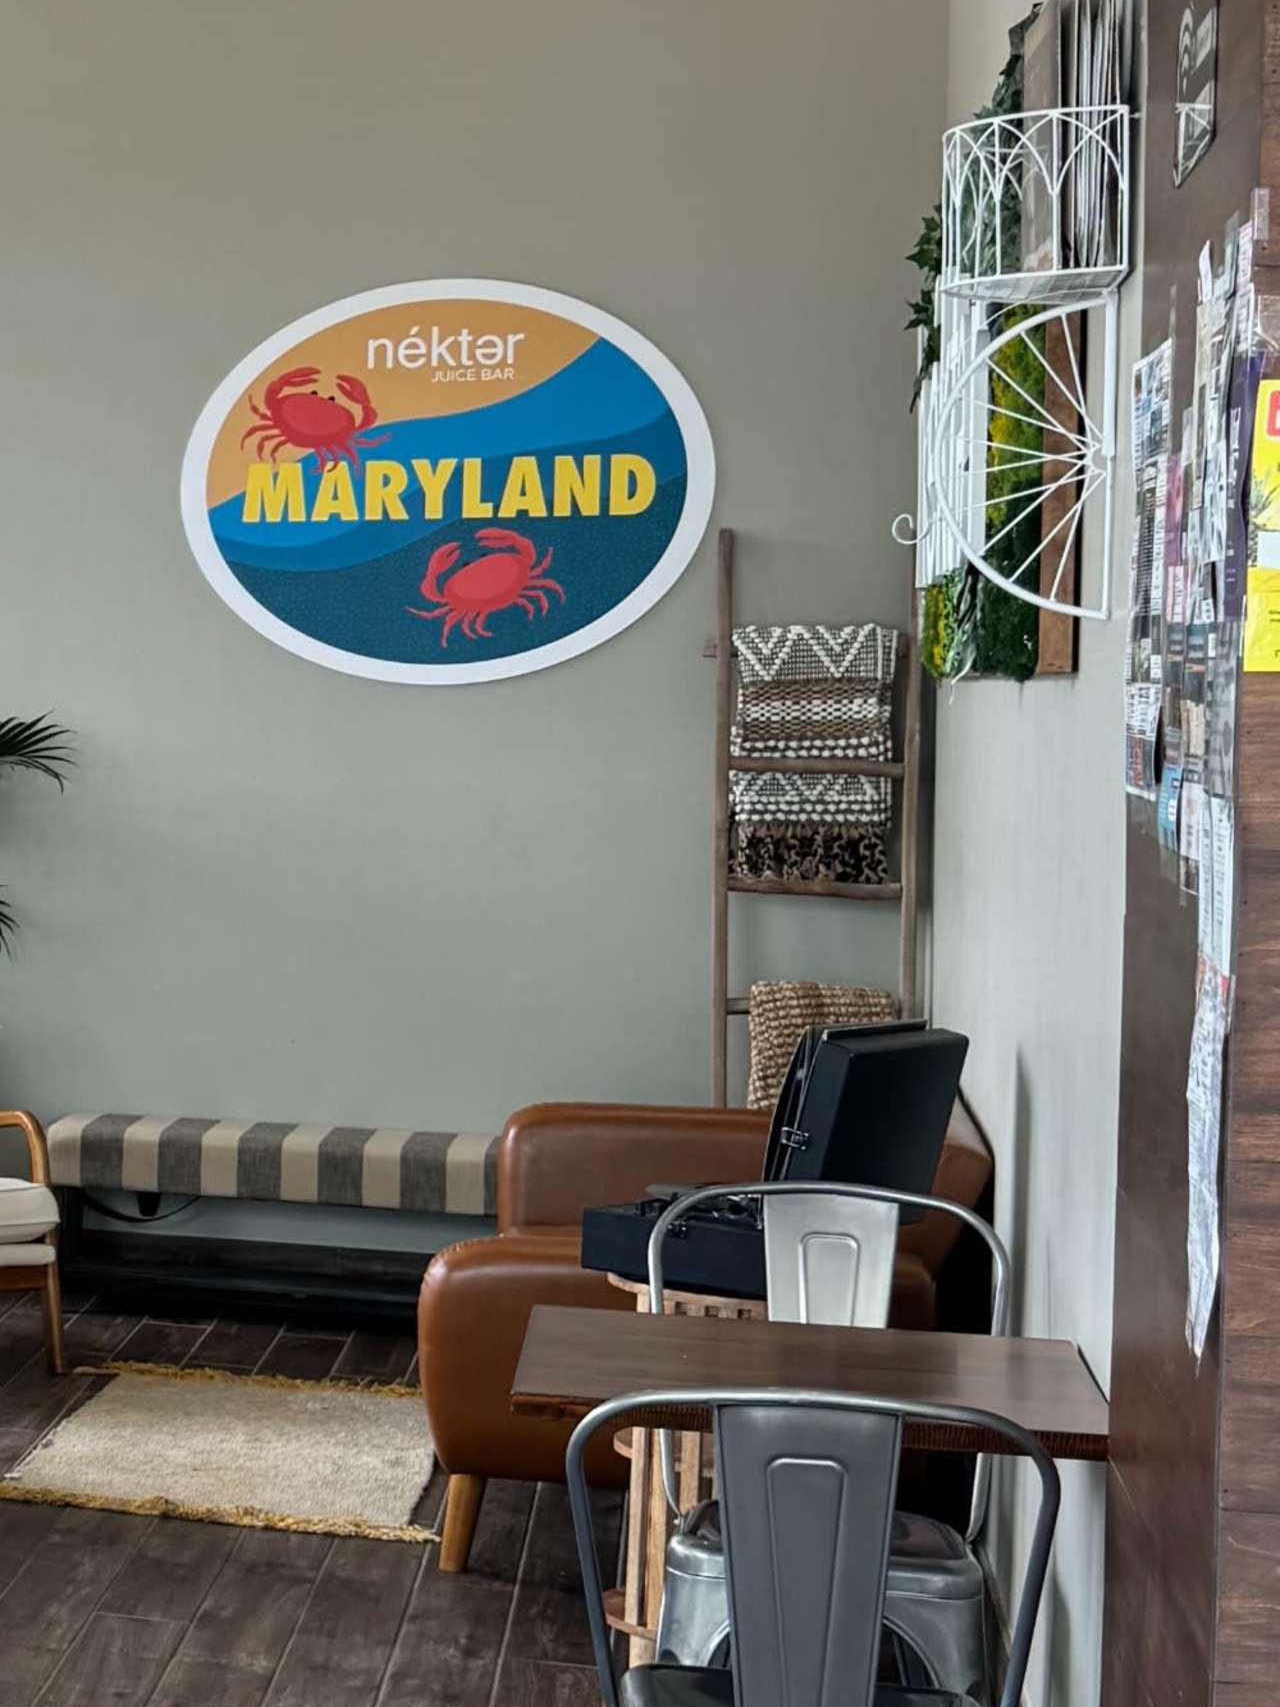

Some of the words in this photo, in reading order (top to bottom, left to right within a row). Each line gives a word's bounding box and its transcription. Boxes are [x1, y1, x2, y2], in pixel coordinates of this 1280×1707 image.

[431, 369, 477, 383] JUICE
[480, 367, 515, 381] BAR
[241, 454, 657, 523] MARYLAND
